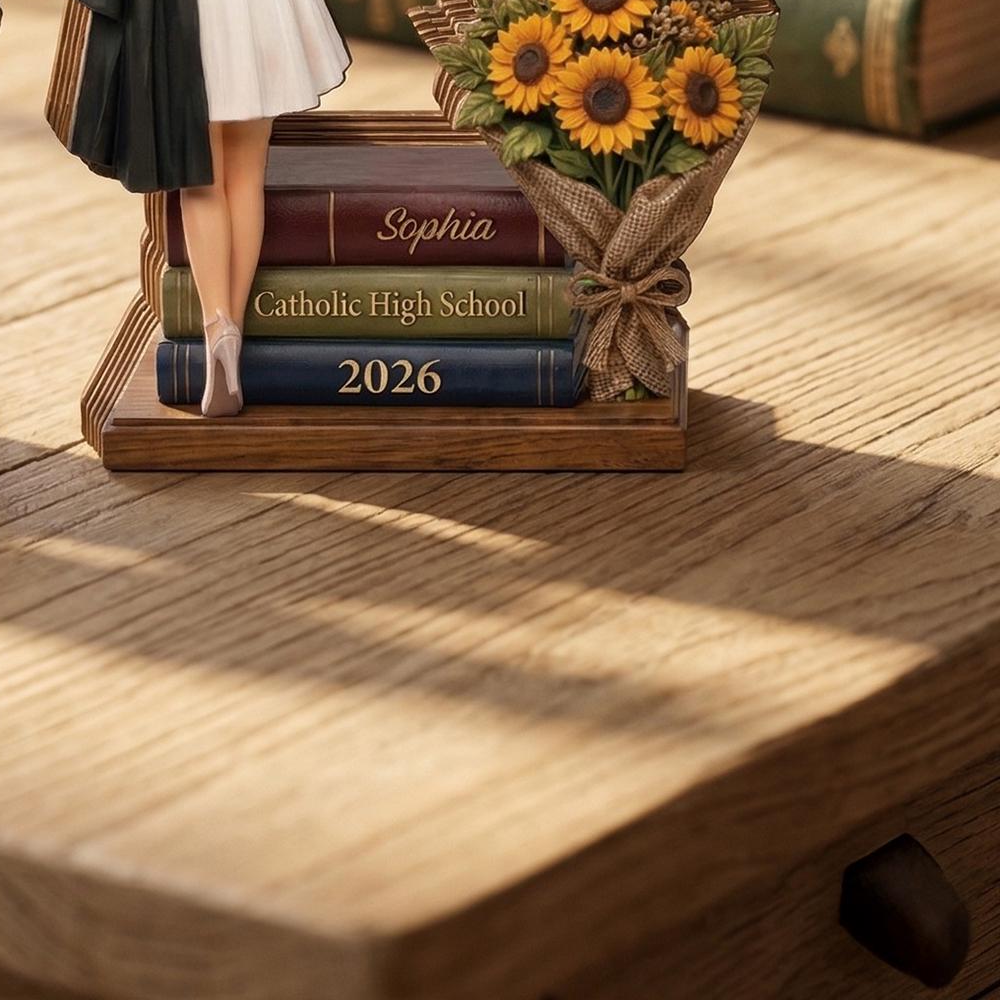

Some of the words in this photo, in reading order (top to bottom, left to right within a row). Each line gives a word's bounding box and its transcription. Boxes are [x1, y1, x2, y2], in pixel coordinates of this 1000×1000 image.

[377, 207, 496, 254] Sophia
[254, 291, 362, 317] Catholic
[369, 291, 433, 325] High
[440, 291, 526, 317] School
[338, 359, 442, 394] 2026
